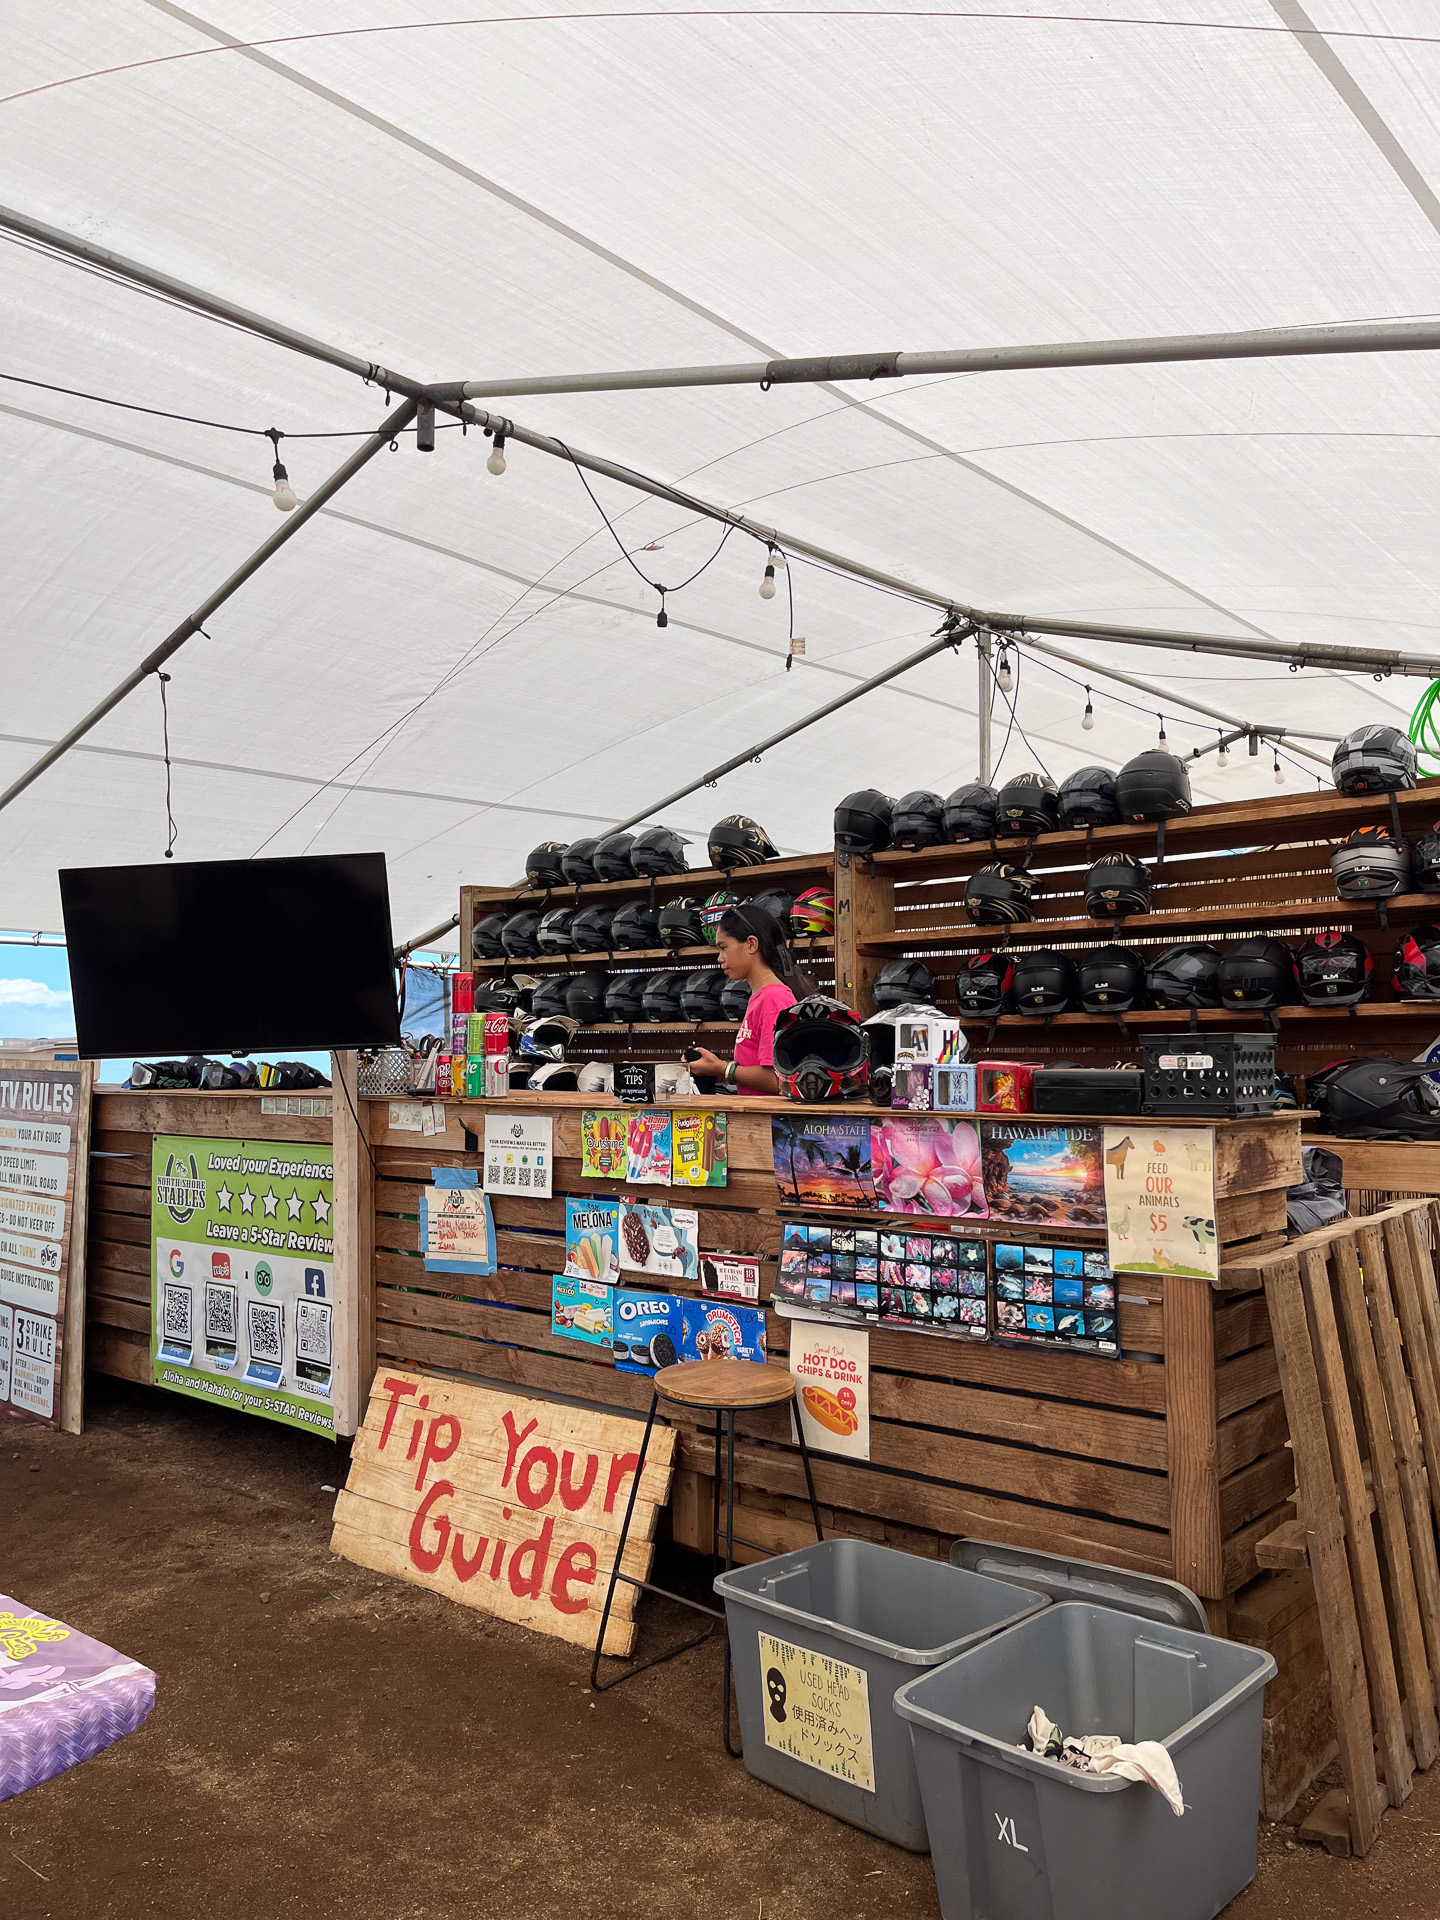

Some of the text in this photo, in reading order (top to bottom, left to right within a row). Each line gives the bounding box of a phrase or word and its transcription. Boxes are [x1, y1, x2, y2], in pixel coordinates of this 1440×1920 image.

[838, 899, 850, 915] M
[624, 1074, 643, 1085] TIPS
[22, 1081, 74, 1114] RULES
[18, 1128, 32, 1141] YOUR
[33, 1130, 44, 1142] ATV
[45, 1131, 62, 1144] GUIDE
[803, 1124, 866, 1136] ALOHA STATE
[991, 1127, 1093, 1142] HAWAII TIDE
[586, 1136, 625, 1149] Outshine
[680, 1143, 696, 1153] FUDGE
[3, 1156, 19, 1169] SPEED
[20, 1158, 37, 1171] LIMIT:
[683, 1152, 696, 1161] POPS
[207, 1153, 334, 1180] Loved your Experience
[1147, 1163, 1168, 1174] FEED
[23, 1174, 38, 1188] TRAIL
[40, 1176, 58, 1190] ROADS
[157, 1176, 206, 1190] NORTH SHORE
[1145, 1176, 1173, 1193] OUR
[157, 1186, 206, 1209] STABLES
[1139, 1195, 1180, 1208] ANIMALS
[26, 1201, 57, 1217] PATHWAYS
[9, 1214, 17, 1226] DO
[17, 1216, 28, 1229] NOT
[29, 1217, 43, 1231] VEER
[44, 1220, 55, 1233] OFF
[572, 1211, 613, 1230] MELONA
[1149, 1213, 1168, 1233] $5
[206, 1220, 239, 1240] Leave
[240, 1227, 249, 1242] a
[250, 1226, 285, 1248] 5-Star
[8, 1241, 18, 1255] ALL
[19, 1244, 37, 1259] TURNS
[0, 1268, 54, 1293] GUIDE INSTRUCTIONS
[724, 1273, 739, 1282] BARS
[745, 1269, 754, 1279] 18
[555, 1285, 576, 1297] MEXICO
[619, 1301, 670, 1321] OREO
[16, 1317, 25, 1349] 3
[26, 1319, 53, 1341] STRIKE
[705, 1309, 742, 1346] DRUMSTICK
[25, 1335, 51, 1357] RULE
[736, 1346, 755, 1355] VARIETY
[803, 1353, 857, 1372] HOT DOG
[797, 1365, 863, 1384] CHIPS & DRINK
[162, 1369, 184, 1385] Aloha
[185, 1376, 200, 1390] and
[201, 1380, 229, 1398] Mahalo
[230, 1388, 243, 1401] for
[243, 1393, 263, 1410] your
[264, 1398, 296, 1418] 5-STAR
[377, 1377, 462, 1492] Tip
[501, 1410, 647, 1513] Your
[409, 1479, 597, 1615] Guide
[800, 1670, 823, 1690] USED
[826, 1679, 850, 1701] HEAD
[811, 1692, 842, 1718] SOCKS
[791, 1704, 863, 1745] 使用済みヘッ
[800, 1727, 859, 1764] ドソックス
[994, 1812, 1029, 1852] XL
